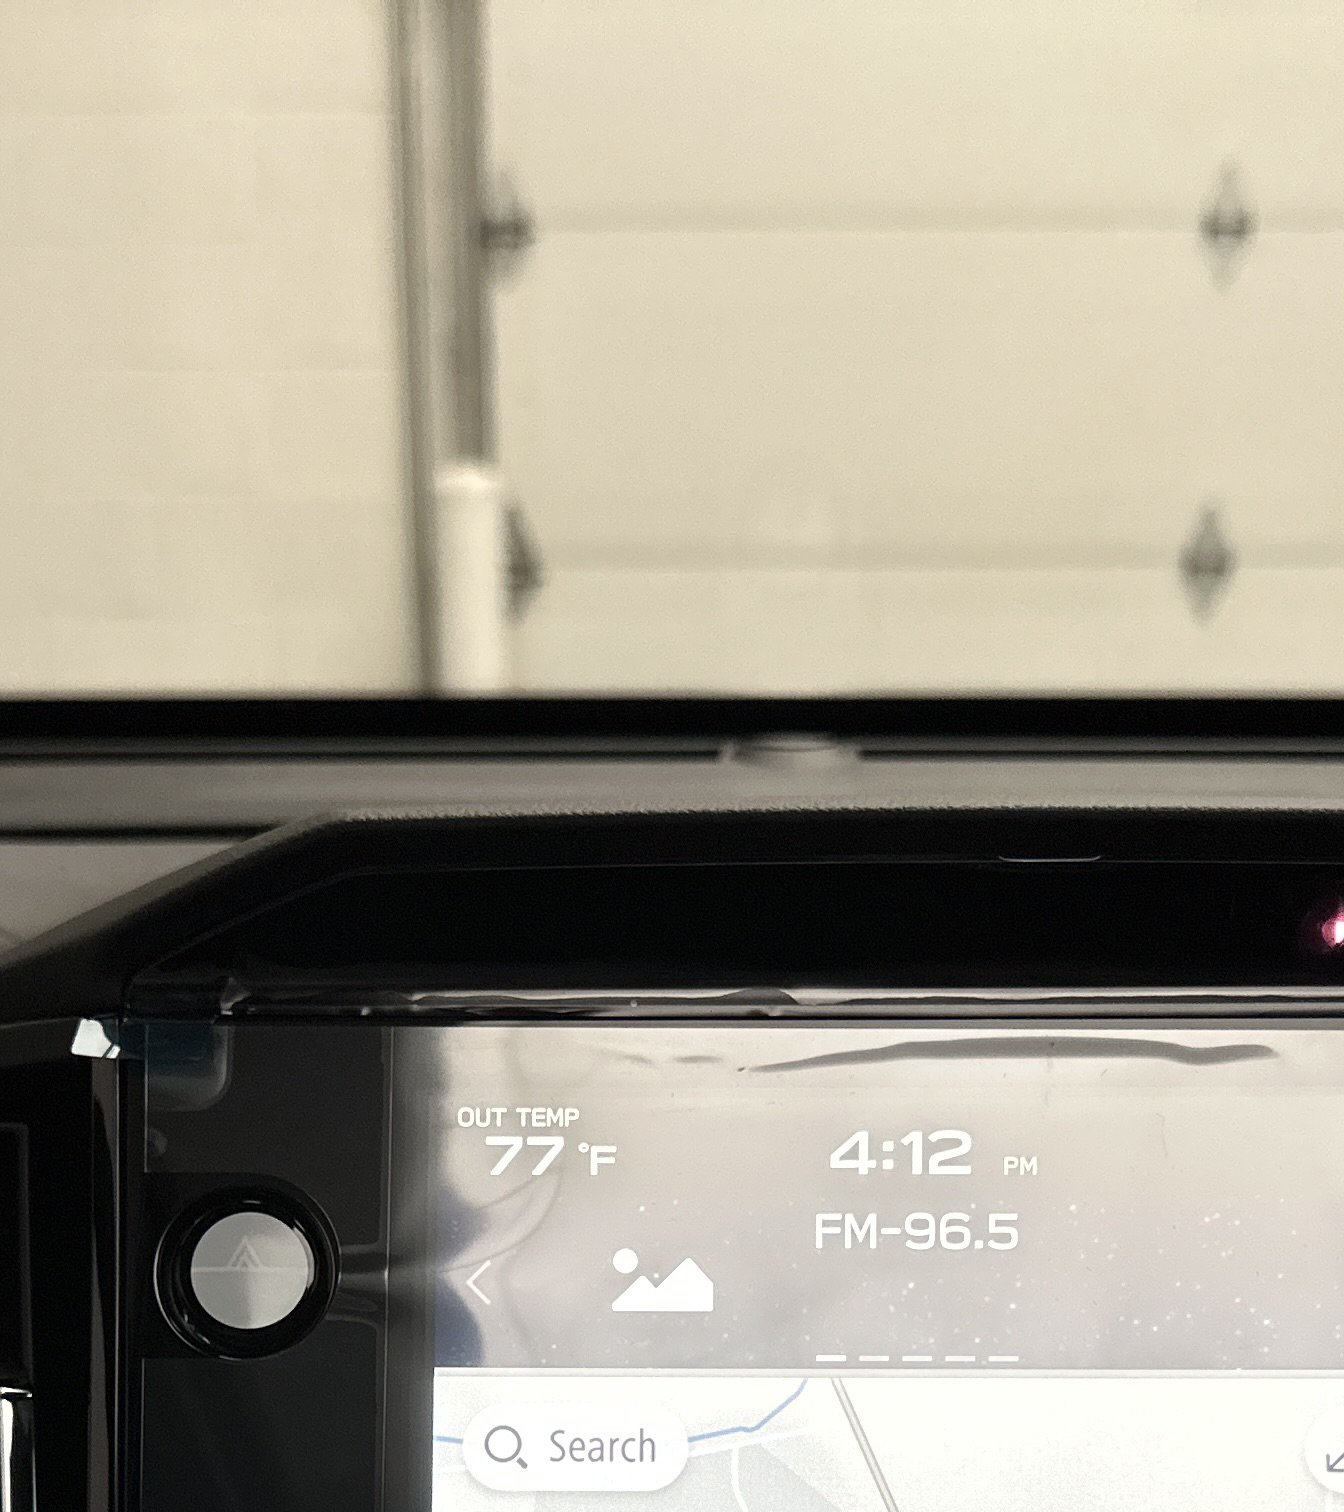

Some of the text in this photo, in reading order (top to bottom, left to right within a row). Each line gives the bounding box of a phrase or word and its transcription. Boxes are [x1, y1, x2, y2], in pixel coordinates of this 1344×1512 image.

[457, 1106, 580, 1128] OUT TEMP
[485, 1135, 565, 1176] 77
[829, 1129, 1039, 1176] 4:12 PM
[814, 1211, 1020, 1251] FM-96.5
[549, 1430, 657, 1467] Search
